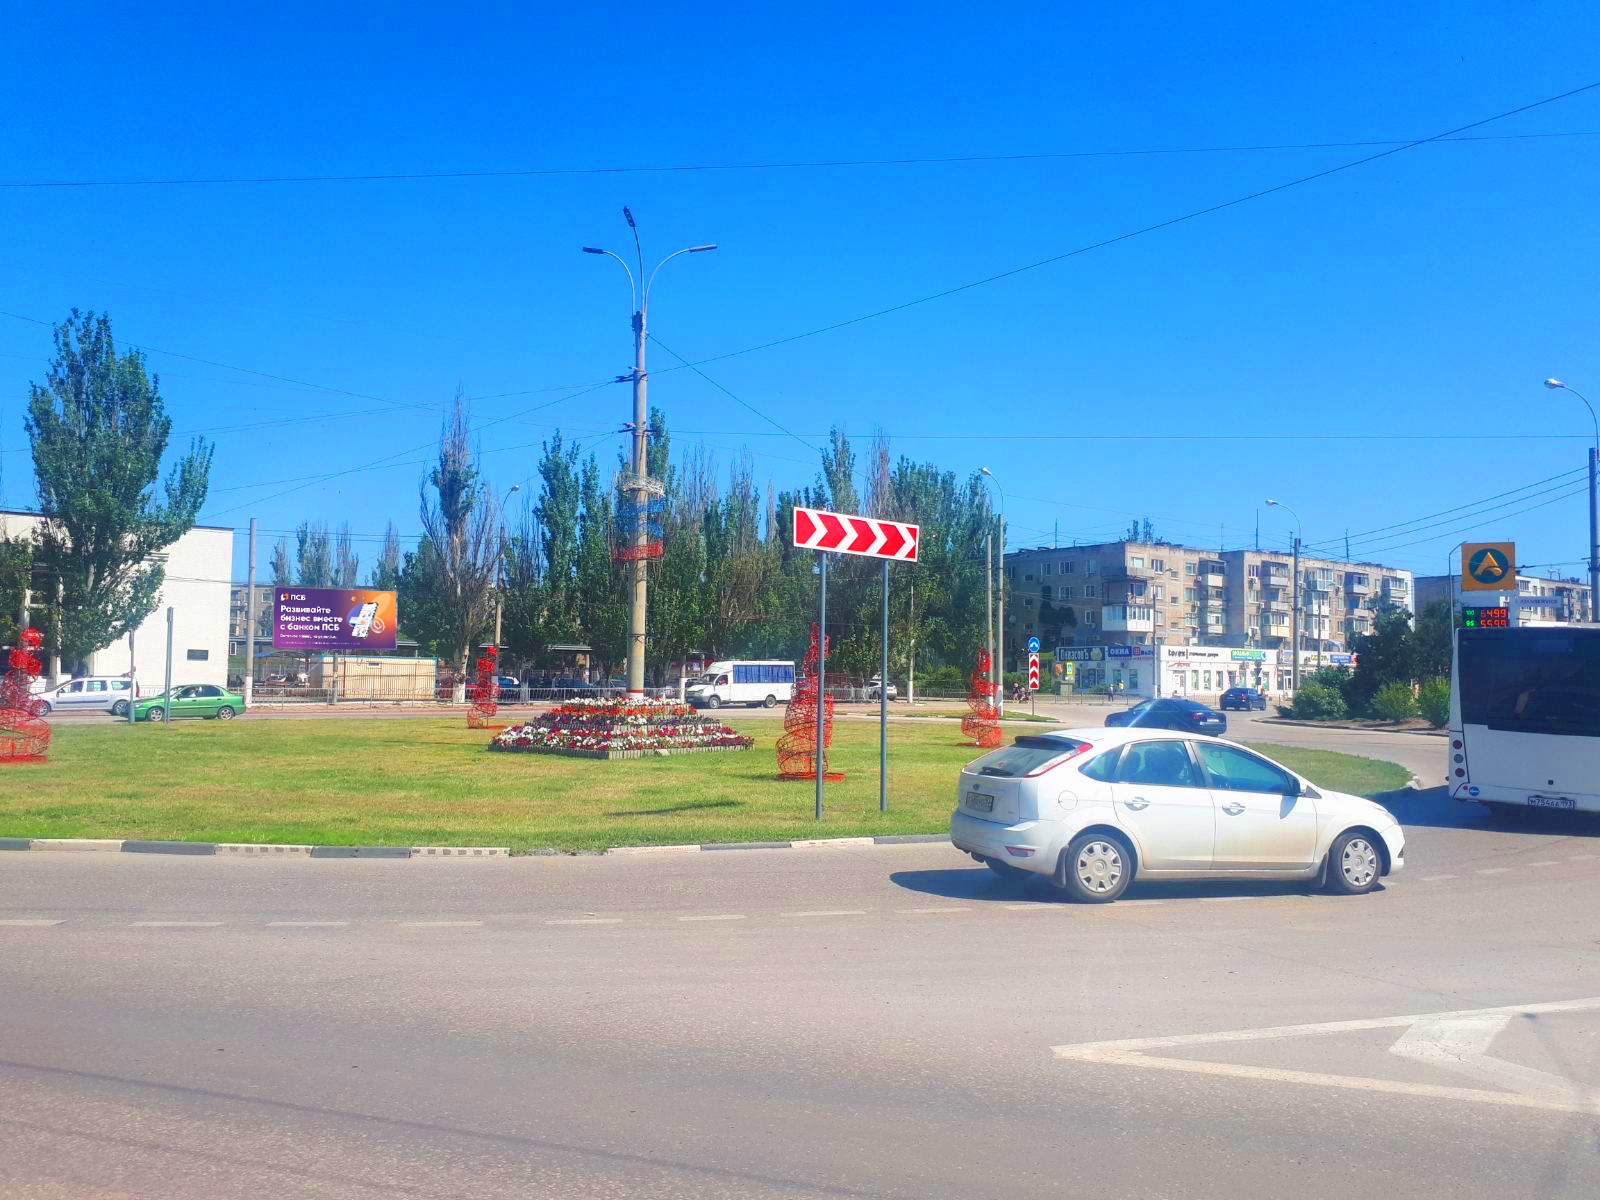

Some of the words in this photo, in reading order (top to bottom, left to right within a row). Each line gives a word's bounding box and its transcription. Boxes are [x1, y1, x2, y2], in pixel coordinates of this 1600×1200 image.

[280, 605, 331, 613] Развивайте
[280, 614, 311, 622] бизнес
[287, 622, 320, 631] банком
